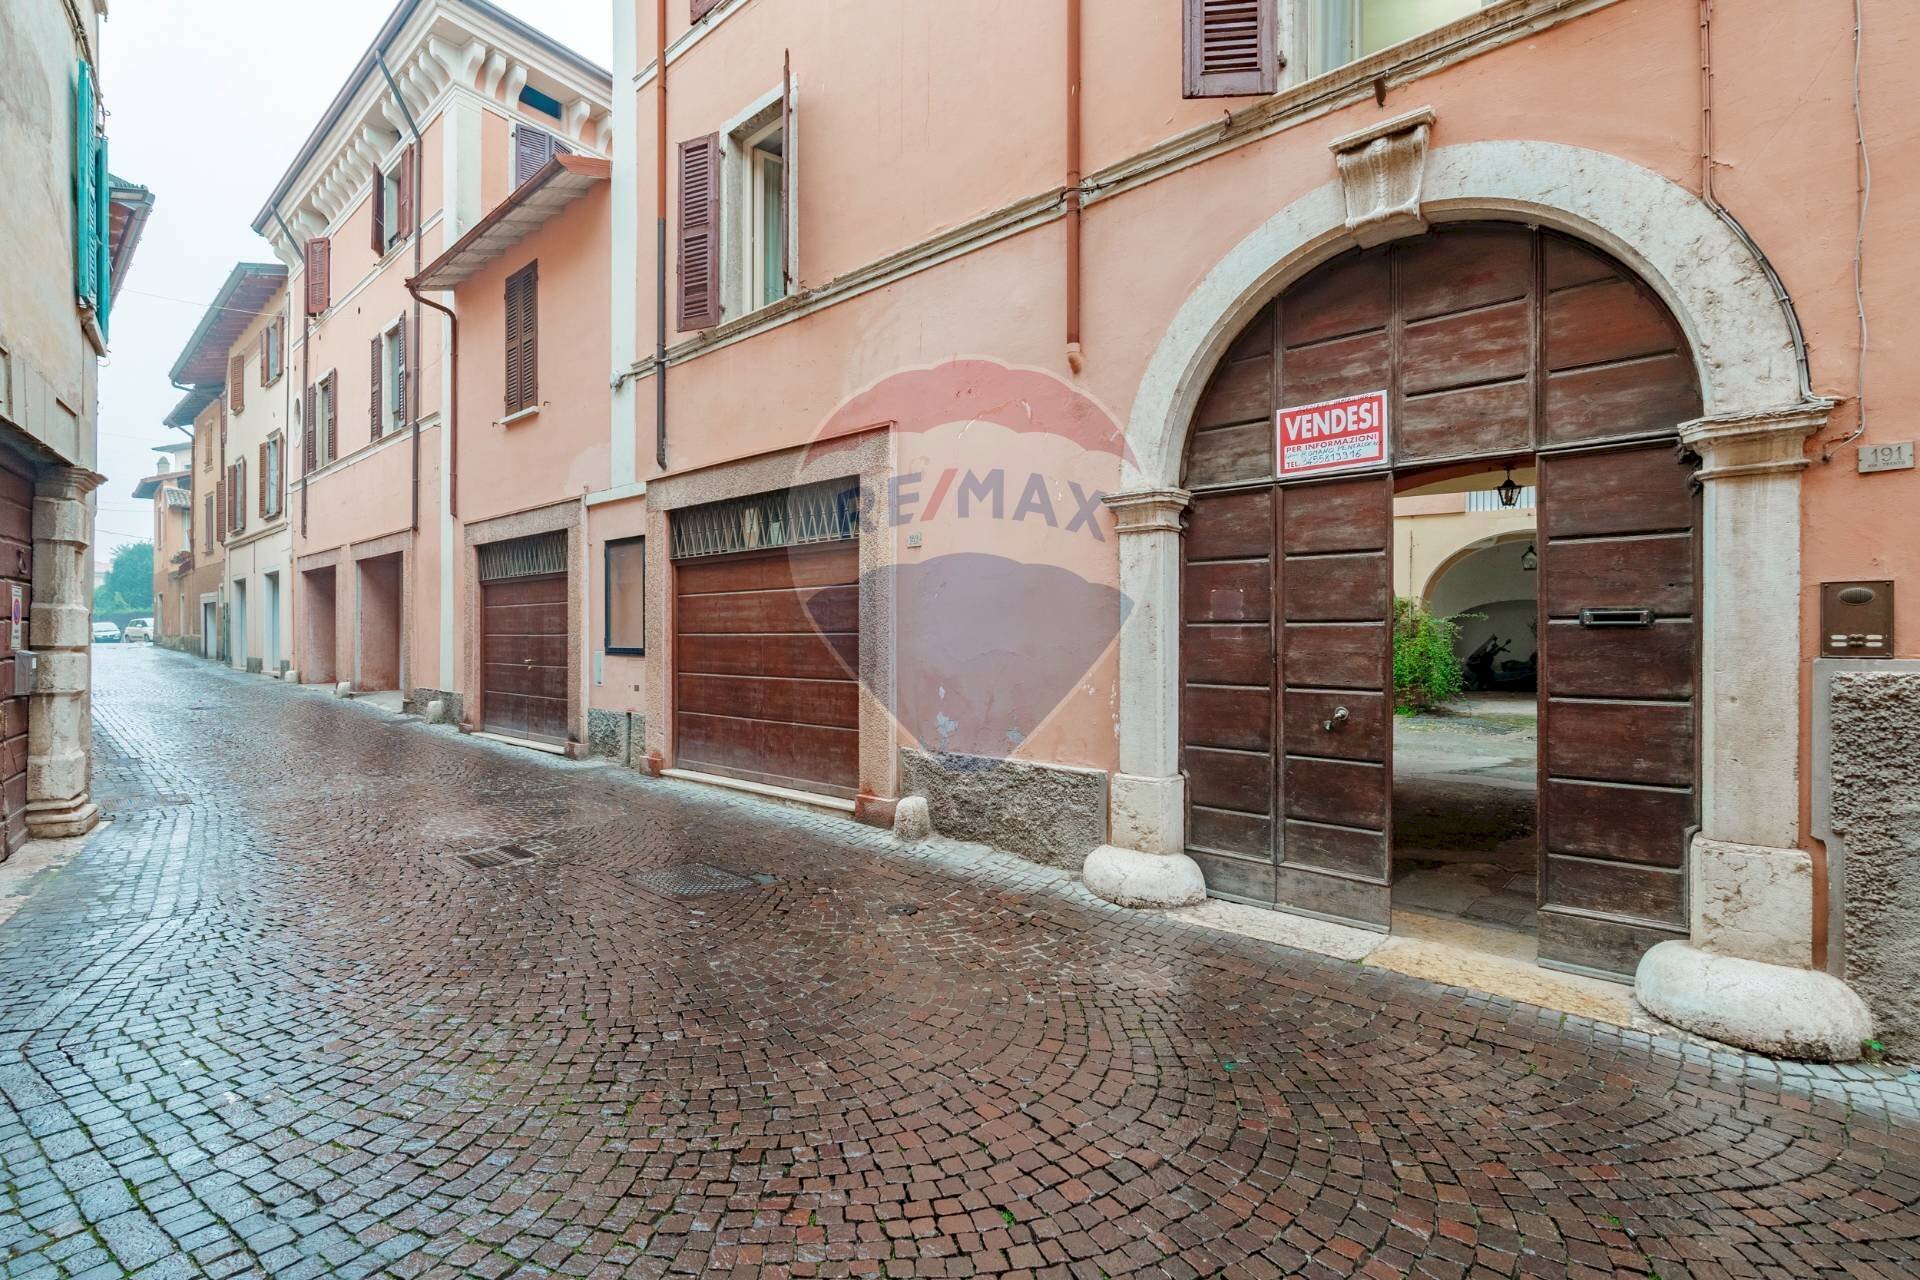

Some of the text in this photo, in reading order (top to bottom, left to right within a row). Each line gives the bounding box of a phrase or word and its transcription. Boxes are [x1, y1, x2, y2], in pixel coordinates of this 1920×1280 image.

[1285, 401, 1379, 441] VENDESI
[1286, 433, 1378, 453] PER INFORMAZIONI
[1871, 445, 1903, 463] 191
